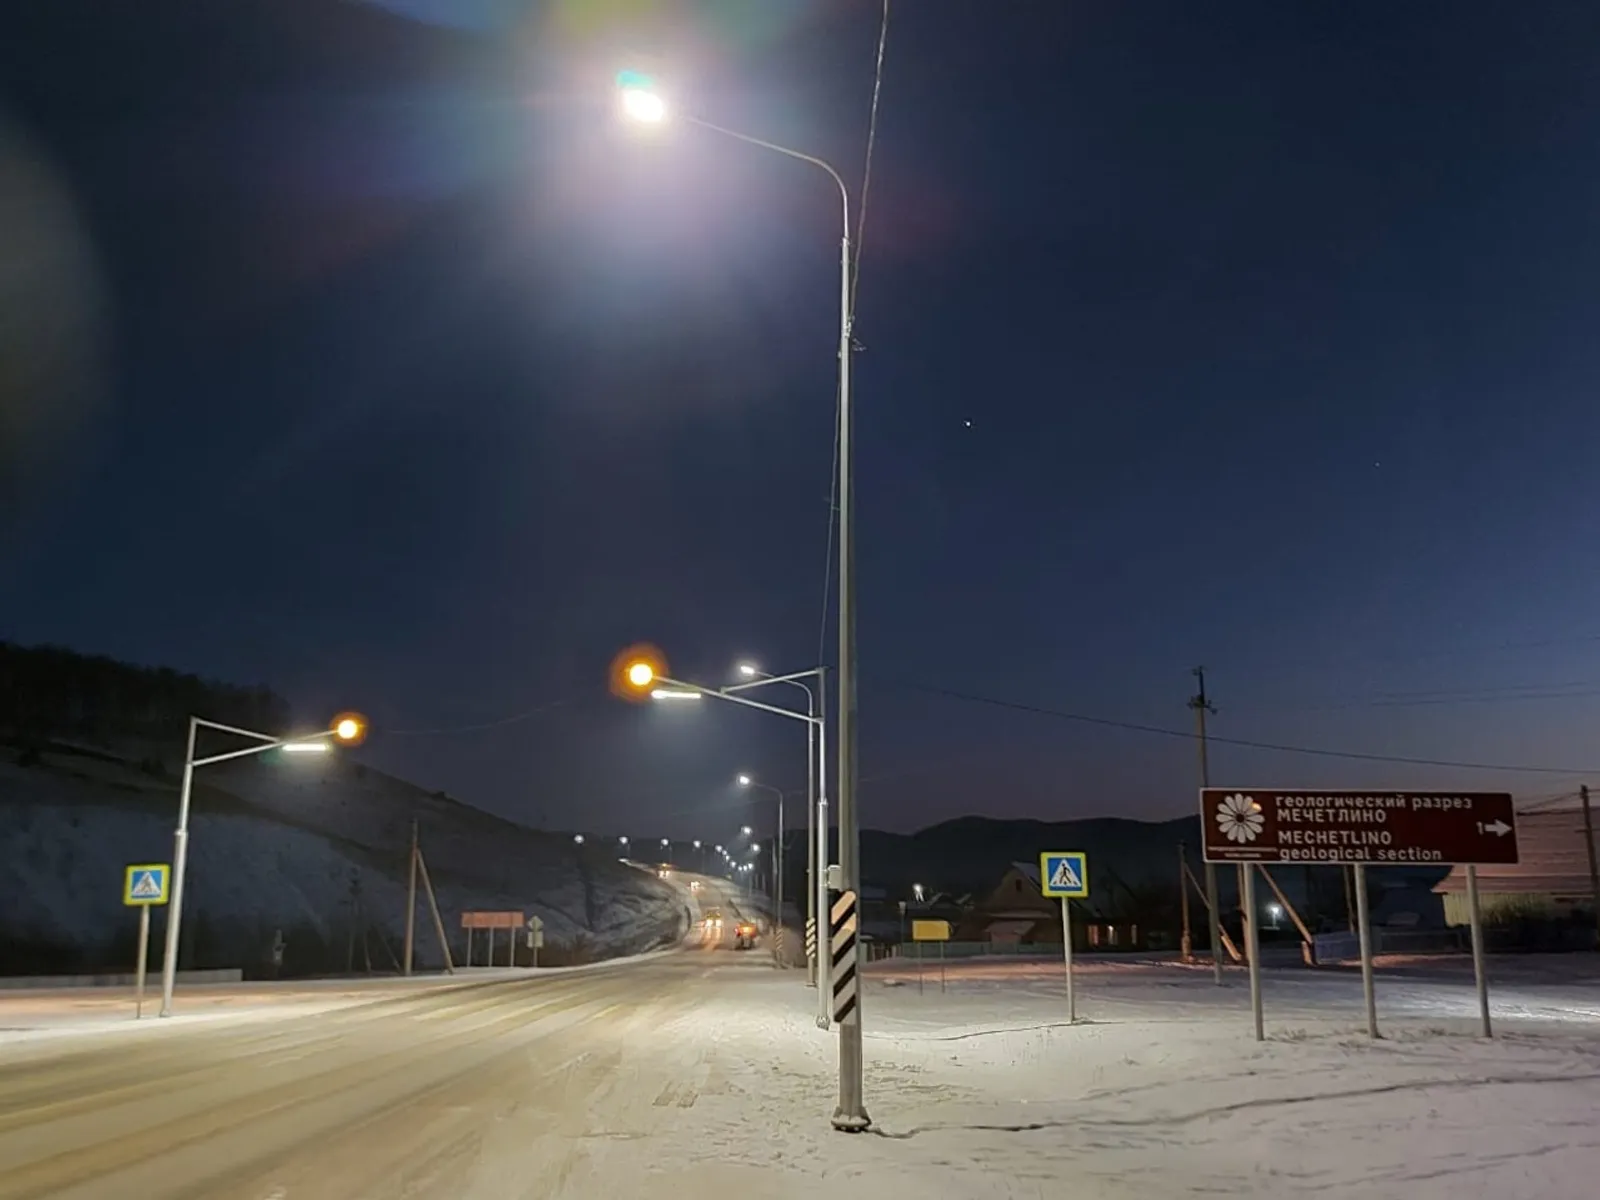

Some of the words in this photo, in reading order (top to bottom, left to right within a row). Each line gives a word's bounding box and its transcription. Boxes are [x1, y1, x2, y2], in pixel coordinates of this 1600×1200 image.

[1275, 794, 1406, 808] геологический
[1412, 797, 1472, 811] разрез
[1277, 809, 1387, 823] МЕЧЕТЛИНО
[1278, 830, 1392, 845] MECHETLINO
[1279, 846, 1371, 861] geological
[1378, 847, 1442, 860] section
